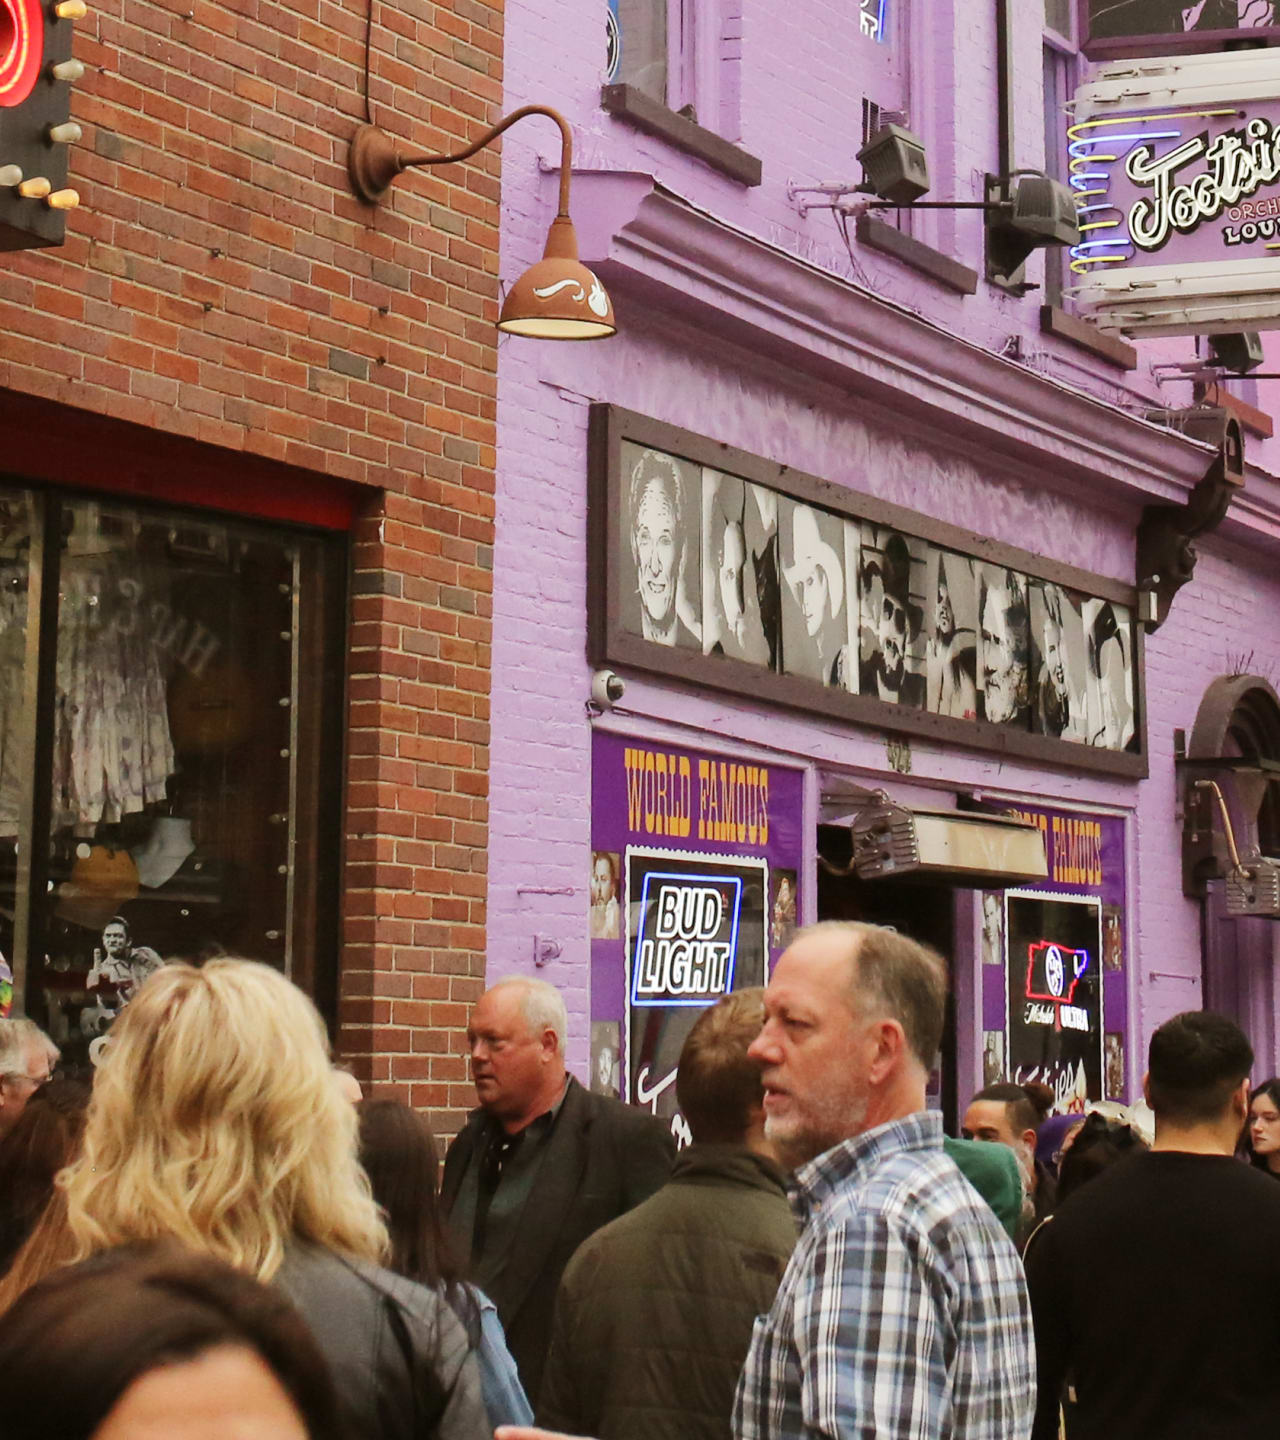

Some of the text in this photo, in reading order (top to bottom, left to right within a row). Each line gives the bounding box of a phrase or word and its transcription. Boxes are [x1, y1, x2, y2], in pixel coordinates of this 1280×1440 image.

[624, 747, 769, 847] WORLD FAMOUS
[1052, 815, 1102, 886] FAMOUS
[656, 885, 723, 940] BUD
[637, 939, 731, 995] LIGHT
[1059, 1004, 1090, 1032] ULTRA
